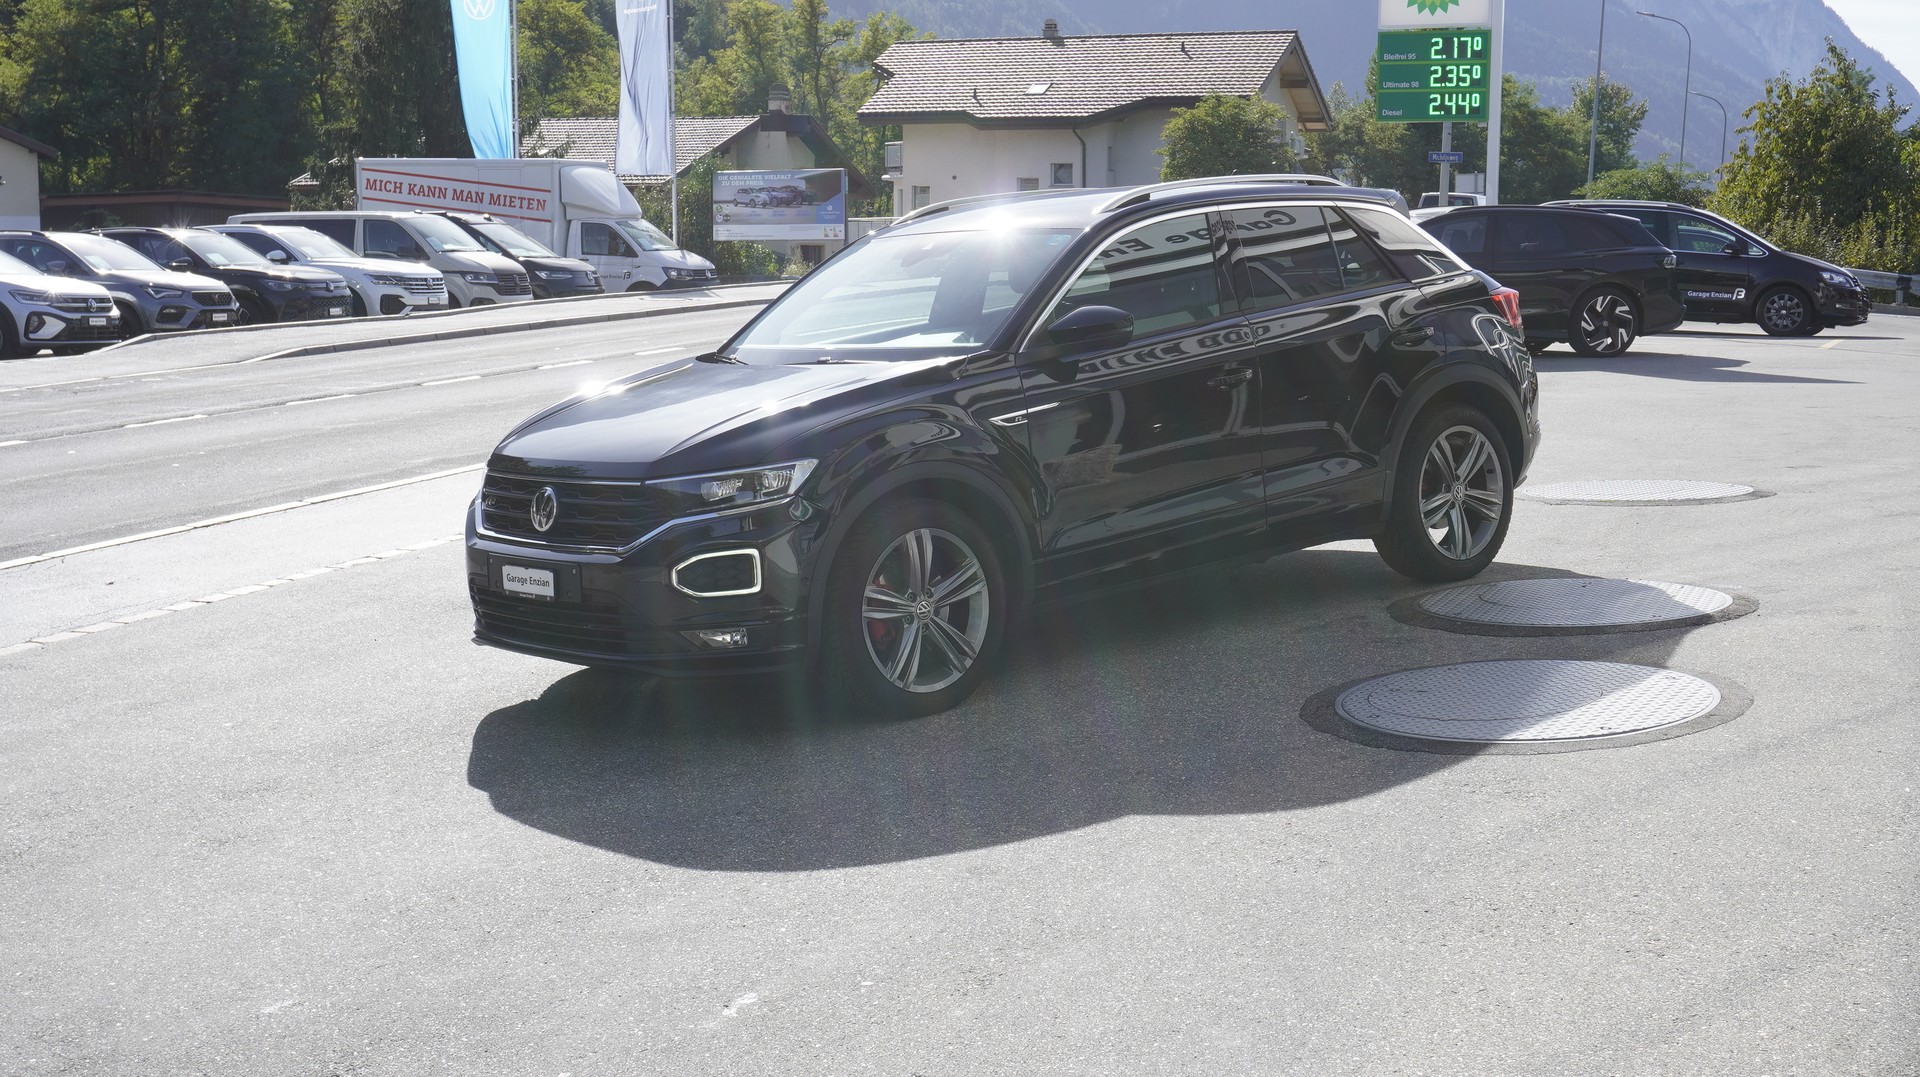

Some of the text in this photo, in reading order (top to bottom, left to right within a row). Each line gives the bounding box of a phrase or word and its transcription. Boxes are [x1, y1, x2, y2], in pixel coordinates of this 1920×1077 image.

[365, 178, 547, 212] MICH KANN MAN MIETEN
[1687, 290, 1710, 298] Garage
[1711, 291, 1732, 299] Enzian
[506, 573, 550, 587] Garage Enzian
